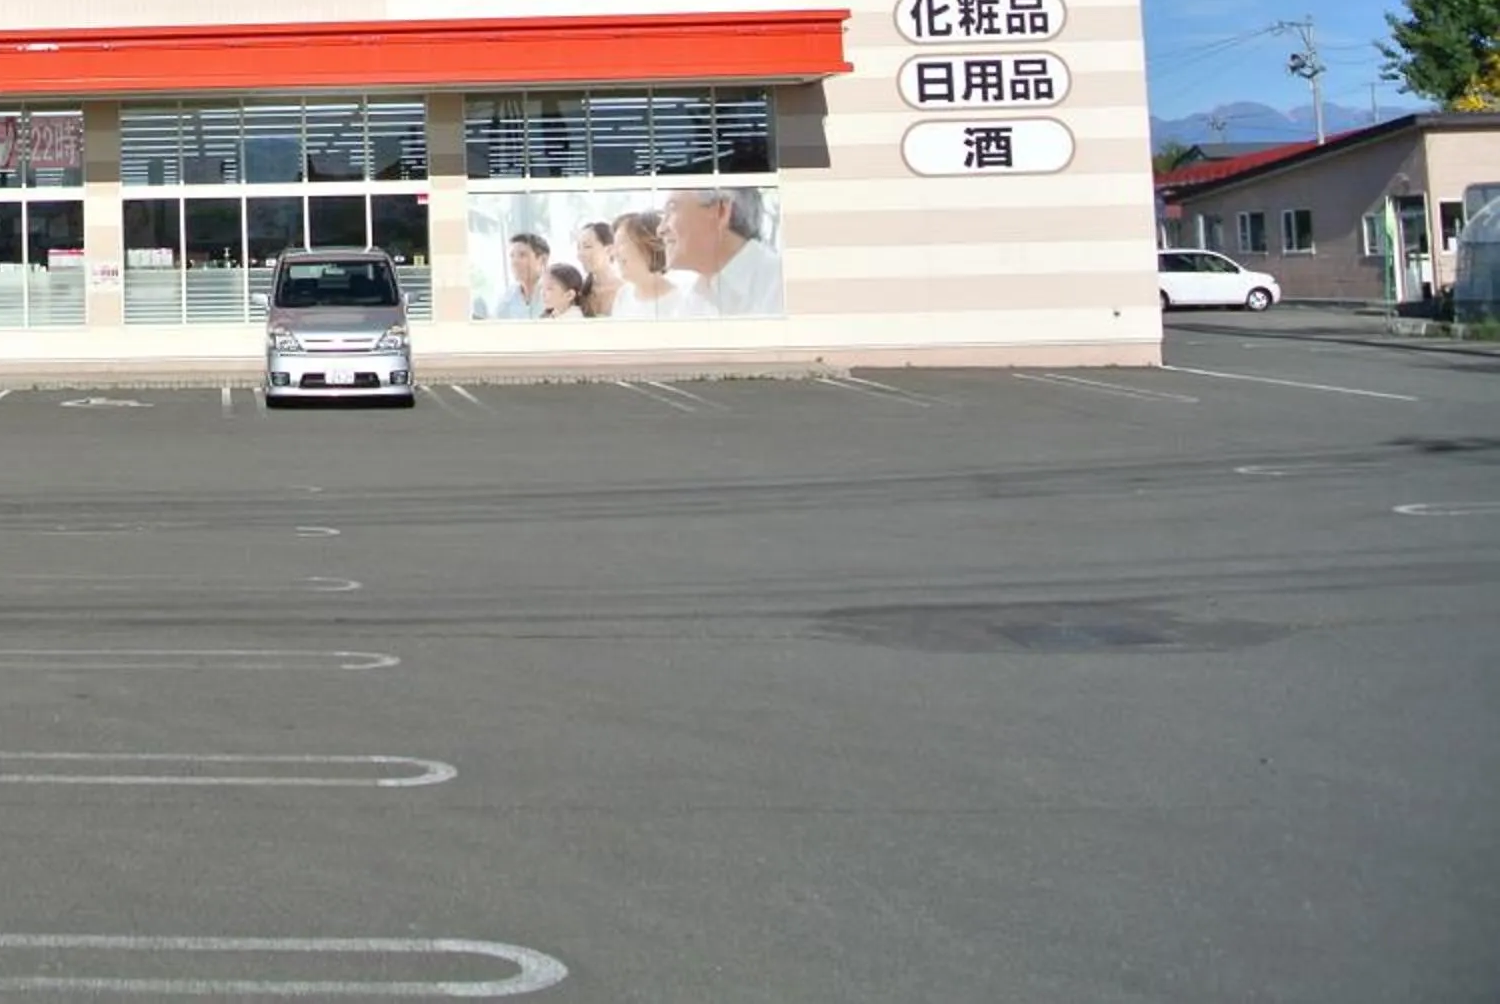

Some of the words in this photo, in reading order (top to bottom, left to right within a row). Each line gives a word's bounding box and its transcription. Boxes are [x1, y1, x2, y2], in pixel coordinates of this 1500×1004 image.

[916, 59, 1054, 103] 日用品
[963, 127, 1013, 168] 酒
